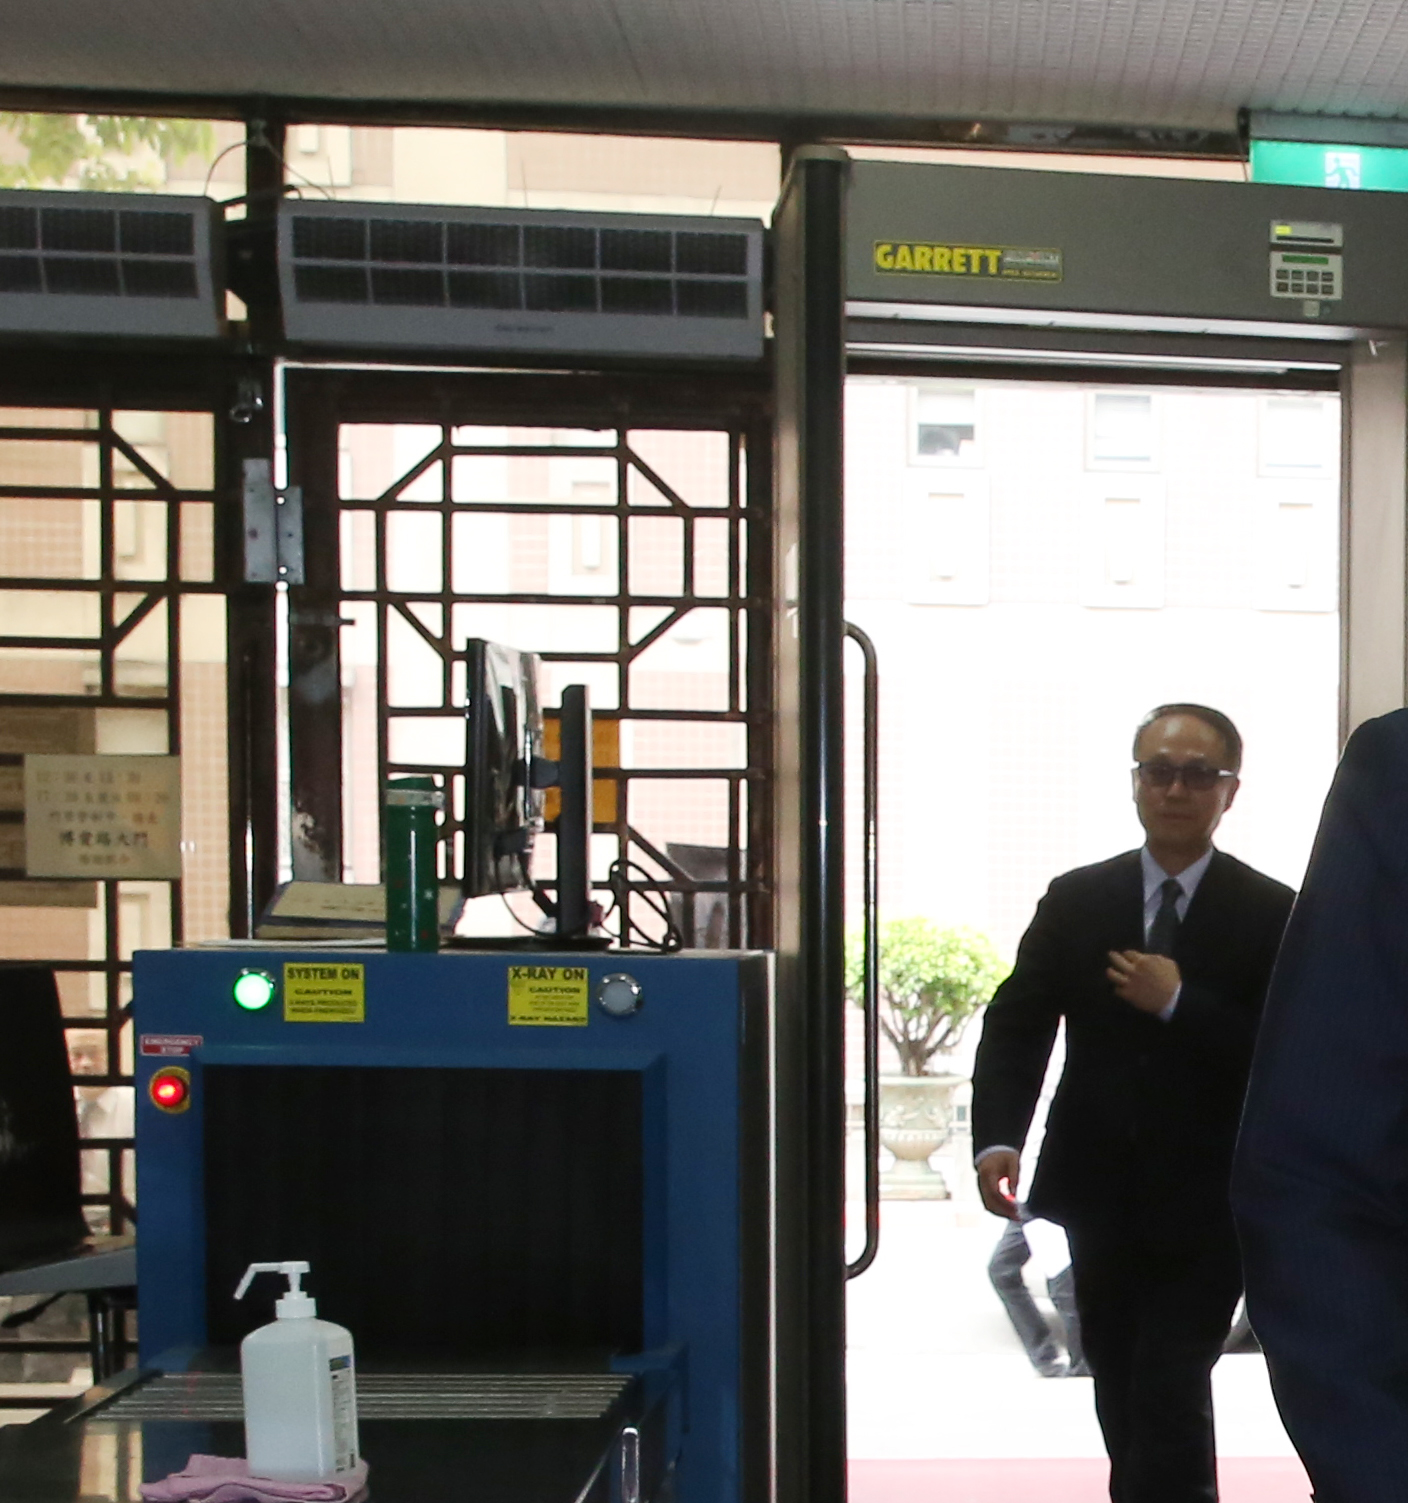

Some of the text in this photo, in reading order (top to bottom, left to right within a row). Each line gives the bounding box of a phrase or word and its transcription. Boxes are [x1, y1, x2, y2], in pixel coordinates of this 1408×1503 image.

[876, 244, 1001, 275] GARRETT
[287, 967, 360, 980] SYSTEM ON
[512, 967, 585, 981] X-RAY ON
